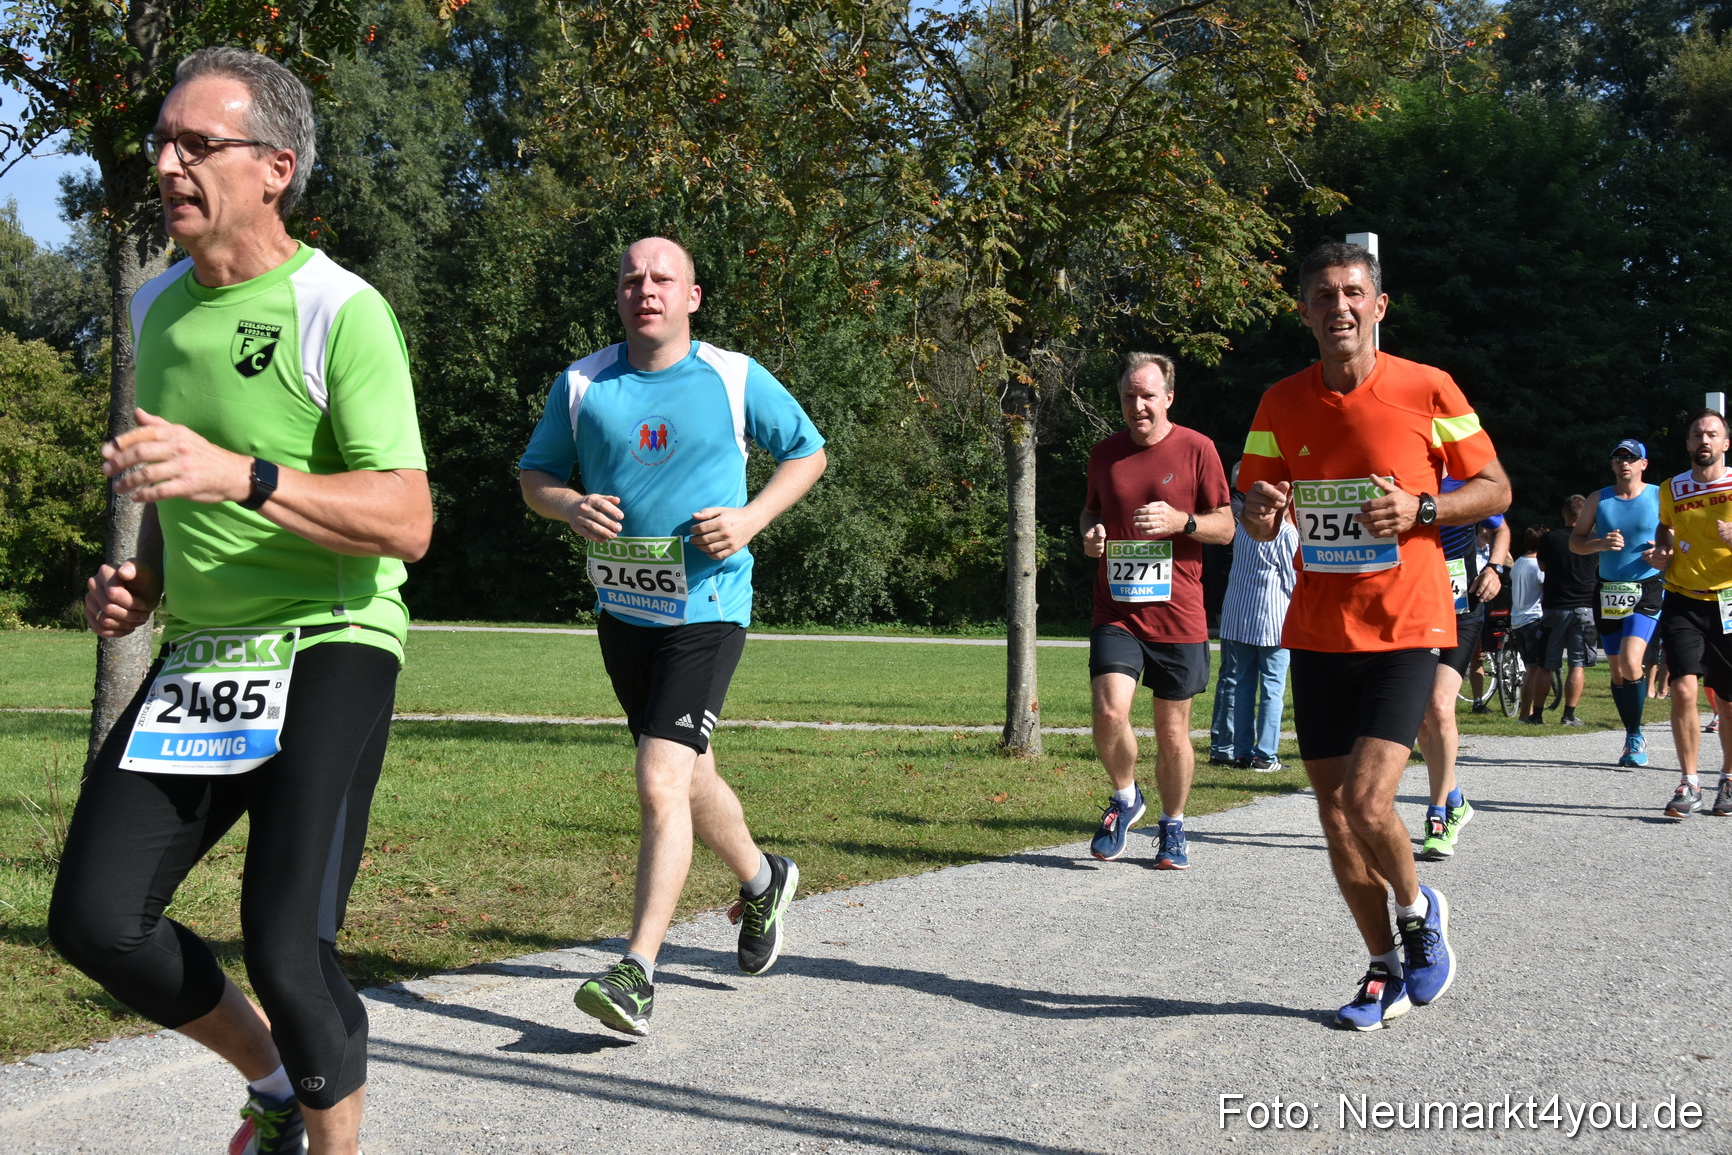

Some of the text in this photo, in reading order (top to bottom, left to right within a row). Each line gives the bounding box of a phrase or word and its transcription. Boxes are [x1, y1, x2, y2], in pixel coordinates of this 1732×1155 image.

[240, 321, 280, 332] EZELSDORF
[239, 337, 255, 355] F
[251, 352, 266, 370] C
[1300, 482, 1382, 505] BOCK
[1674, 499, 1705, 514] MAX
[593, 541, 675, 561] BOCK
[1111, 544, 1165, 557] BOCK
[1316, 549, 1377, 562] RONALD
[597, 565, 677, 593] 2466
[1113, 562, 1161, 581] 2271
[1120, 586, 1154, 595] FRANK
[607, 591, 677, 614] RAINHARD
[1605, 594, 1635, 607] 1249
[166, 634, 283, 669] BOCK
[156, 680, 271, 723] 2485
[161, 737, 246, 757] LUDWIG
